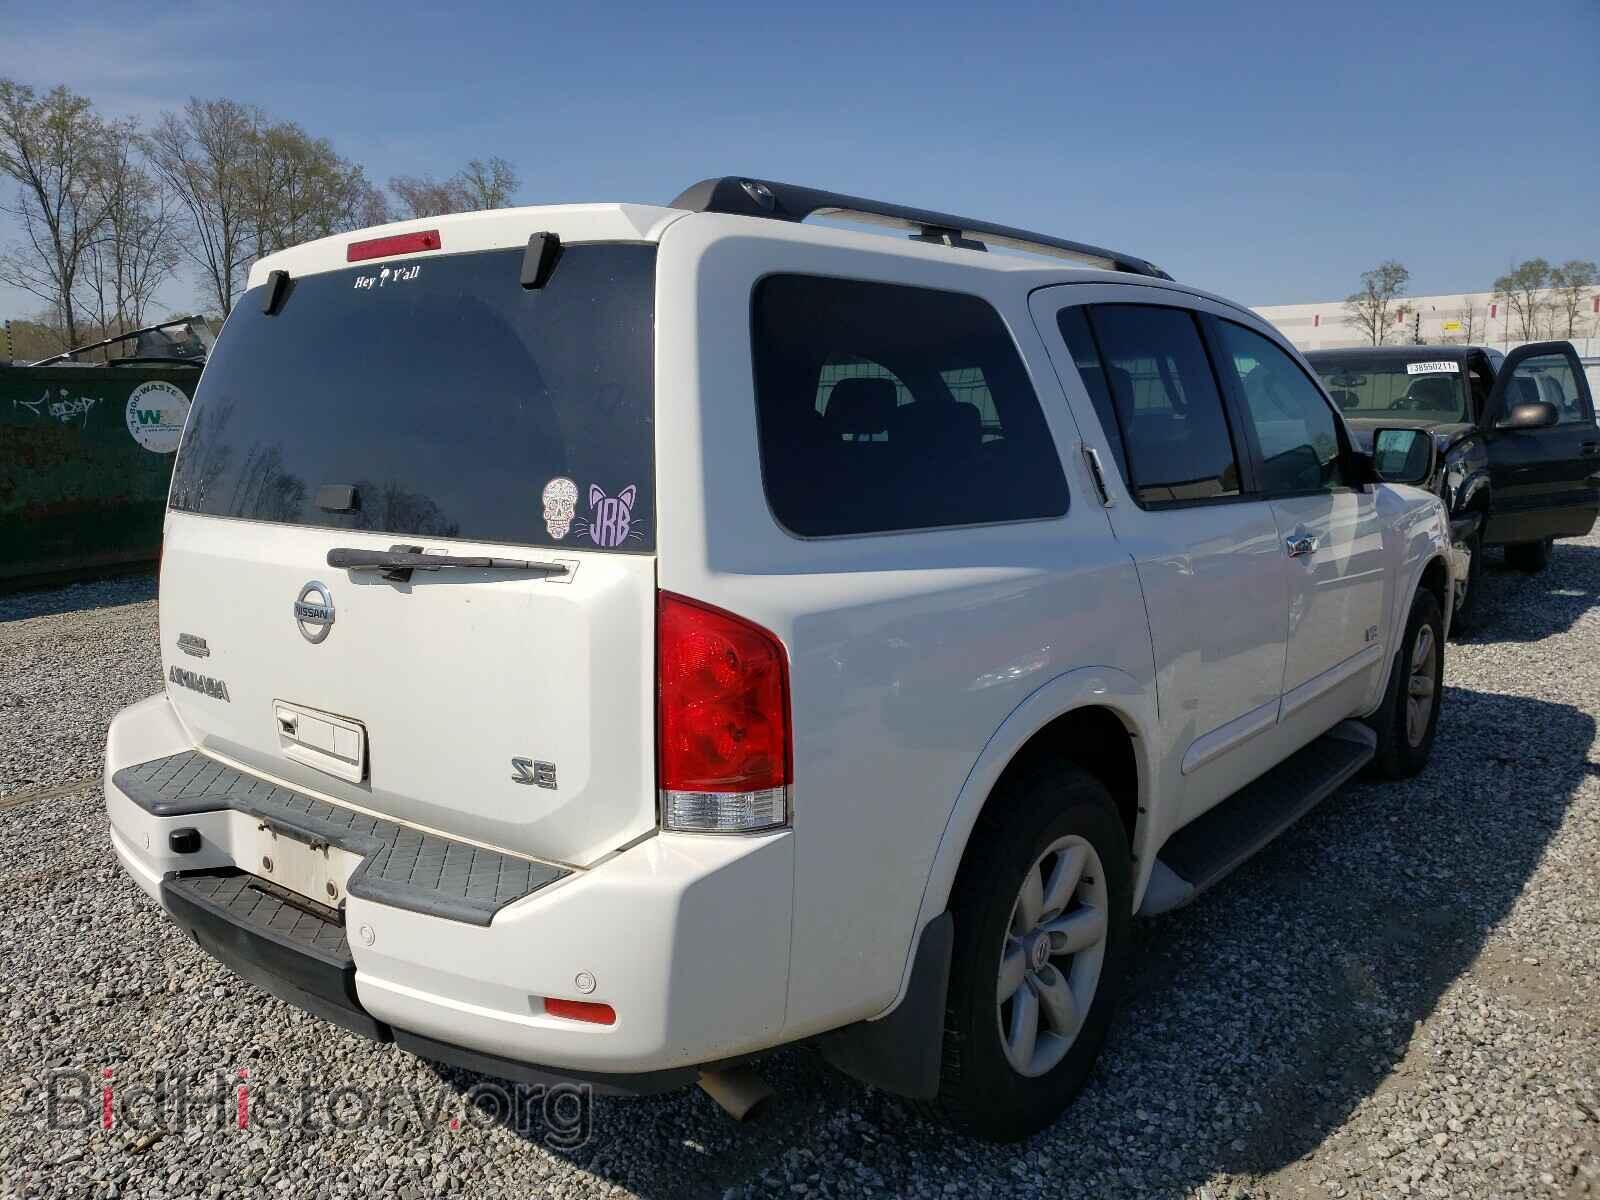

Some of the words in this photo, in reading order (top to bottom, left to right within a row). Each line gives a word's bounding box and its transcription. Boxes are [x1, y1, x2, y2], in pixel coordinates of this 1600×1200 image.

[354, 276, 376, 290] Hey
[393, 265, 420, 282] Y'all
[589, 497, 632, 547] JRB
[295, 605, 329, 620] NISSAN
[511, 756, 558, 791] SE
